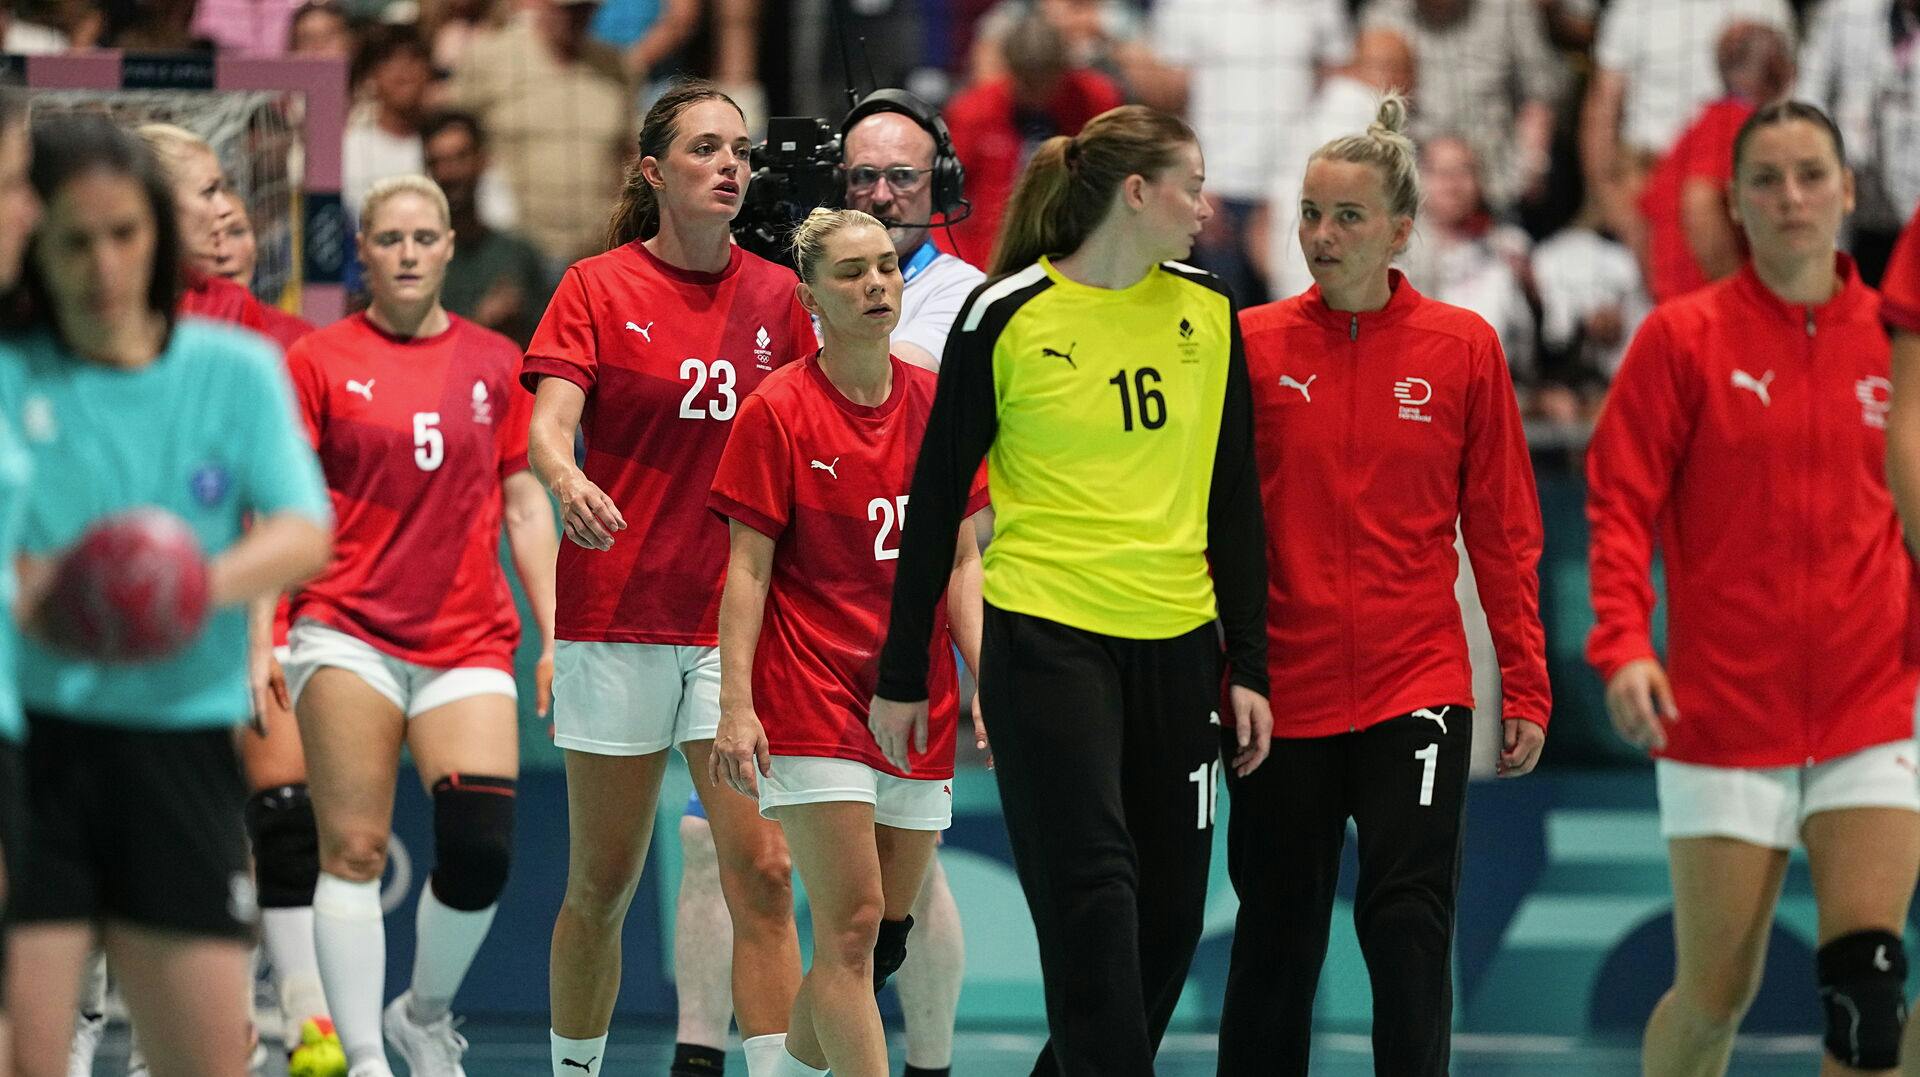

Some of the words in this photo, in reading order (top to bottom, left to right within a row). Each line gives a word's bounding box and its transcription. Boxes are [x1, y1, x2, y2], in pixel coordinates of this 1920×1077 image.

[679, 358, 737, 421] 23
[1109, 366, 1168, 432] 16
[413, 411, 444, 472] 5
[1414, 743, 1439, 806] 1
